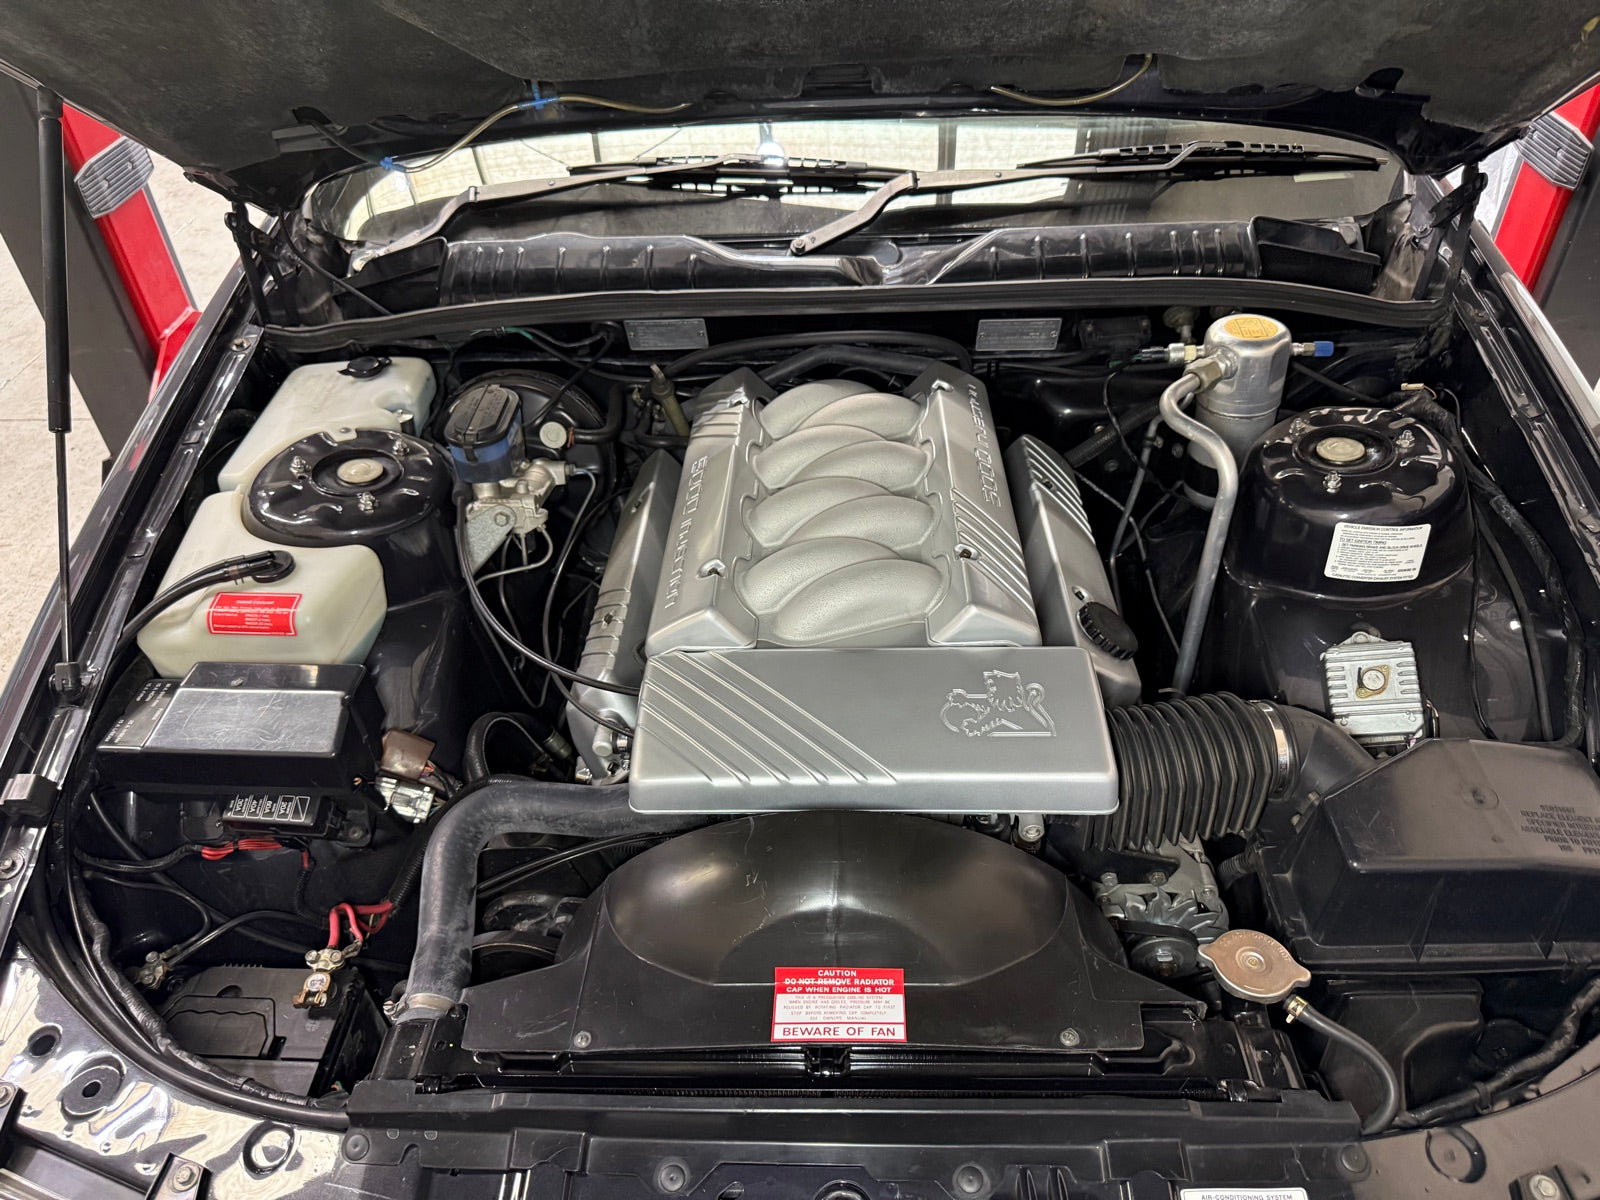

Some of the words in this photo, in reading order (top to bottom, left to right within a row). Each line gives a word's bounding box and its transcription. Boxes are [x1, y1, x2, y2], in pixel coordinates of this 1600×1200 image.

[975, 448, 1001, 507] 5000
[683, 456, 708, 515] 5000
[264, 801, 272, 814] 60A
[279, 802, 287, 814] 20A
[783, 1027, 839, 1036] BEWARE
[846, 1027, 864, 1036] OF
[872, 1027, 895, 1036] FAN
